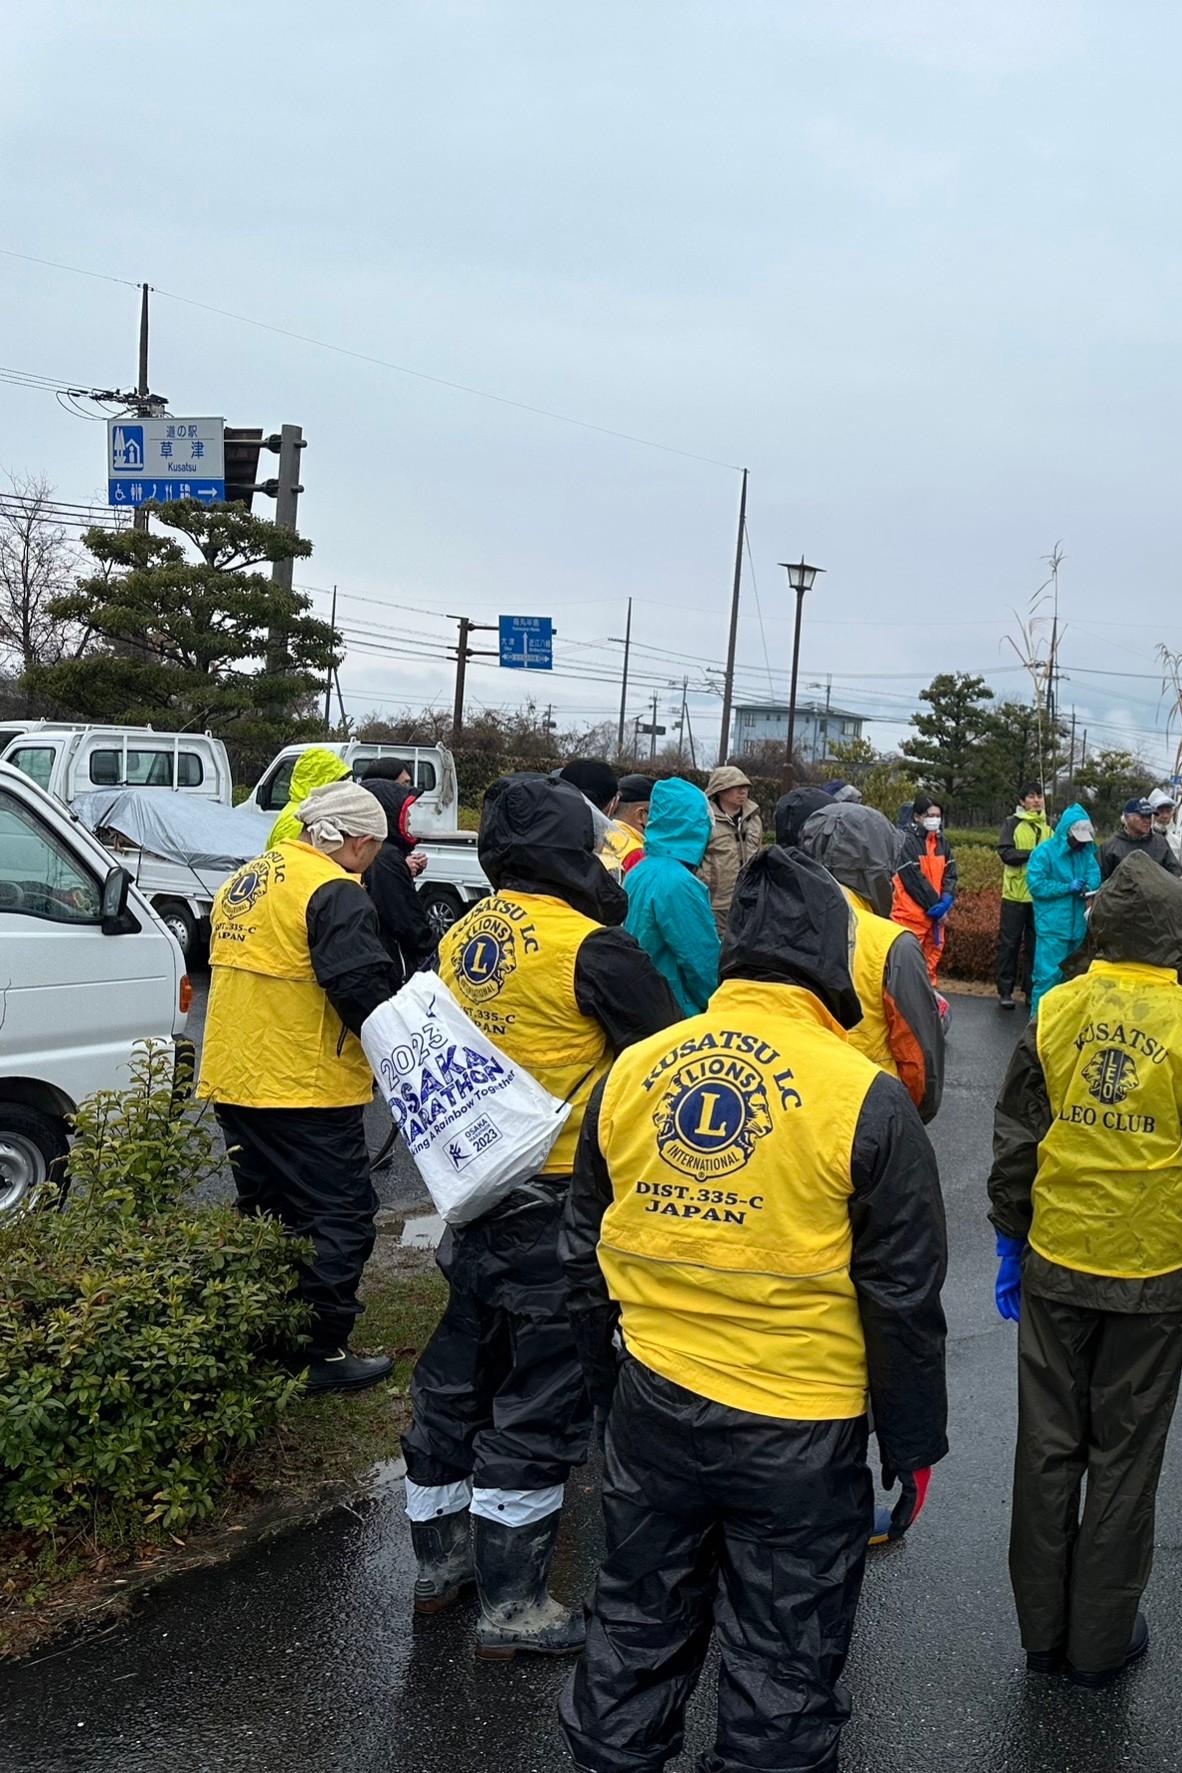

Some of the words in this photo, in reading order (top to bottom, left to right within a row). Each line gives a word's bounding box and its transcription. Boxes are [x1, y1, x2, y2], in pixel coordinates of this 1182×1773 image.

[166, 425, 198, 438] 道の駅
[160, 441, 205, 459] 草津
[168, 462, 197, 472] Kusatsu
[473, 919, 508, 938] LIONS
[520, 924, 539, 953] LC
[471, 942, 488, 974] L
[463, 1006, 516, 1025] ST.335-C
[474, 1020, 506, 1035] PAN
[380, 1023, 448, 1091] 2023
[1073, 1023, 1169, 1065] KUSATSU
[641, 1030, 781, 1092] KUSATSU
[773, 1068, 802, 1111] LC
[686, 1059, 756, 1088] LIONS
[1103, 1051, 1117, 1099] LEO
[388, 1045, 489, 1129] OSAKA
[434, 1100, 475, 1134] Rainbow
[474, 1069, 515, 1101] Together
[695, 1092, 727, 1137] L
[465, 1119, 487, 1138] OSAKA
[1058, 1105, 1097, 1126] LEO
[1103, 1111, 1155, 1133] CLUB
[473, 1129, 498, 1152] 2023
[668, 1145, 740, 1171] INTERNATIONAL
[636, 1181, 764, 1209] DIST.335-C
[645, 1200, 746, 1225] JAPAN
